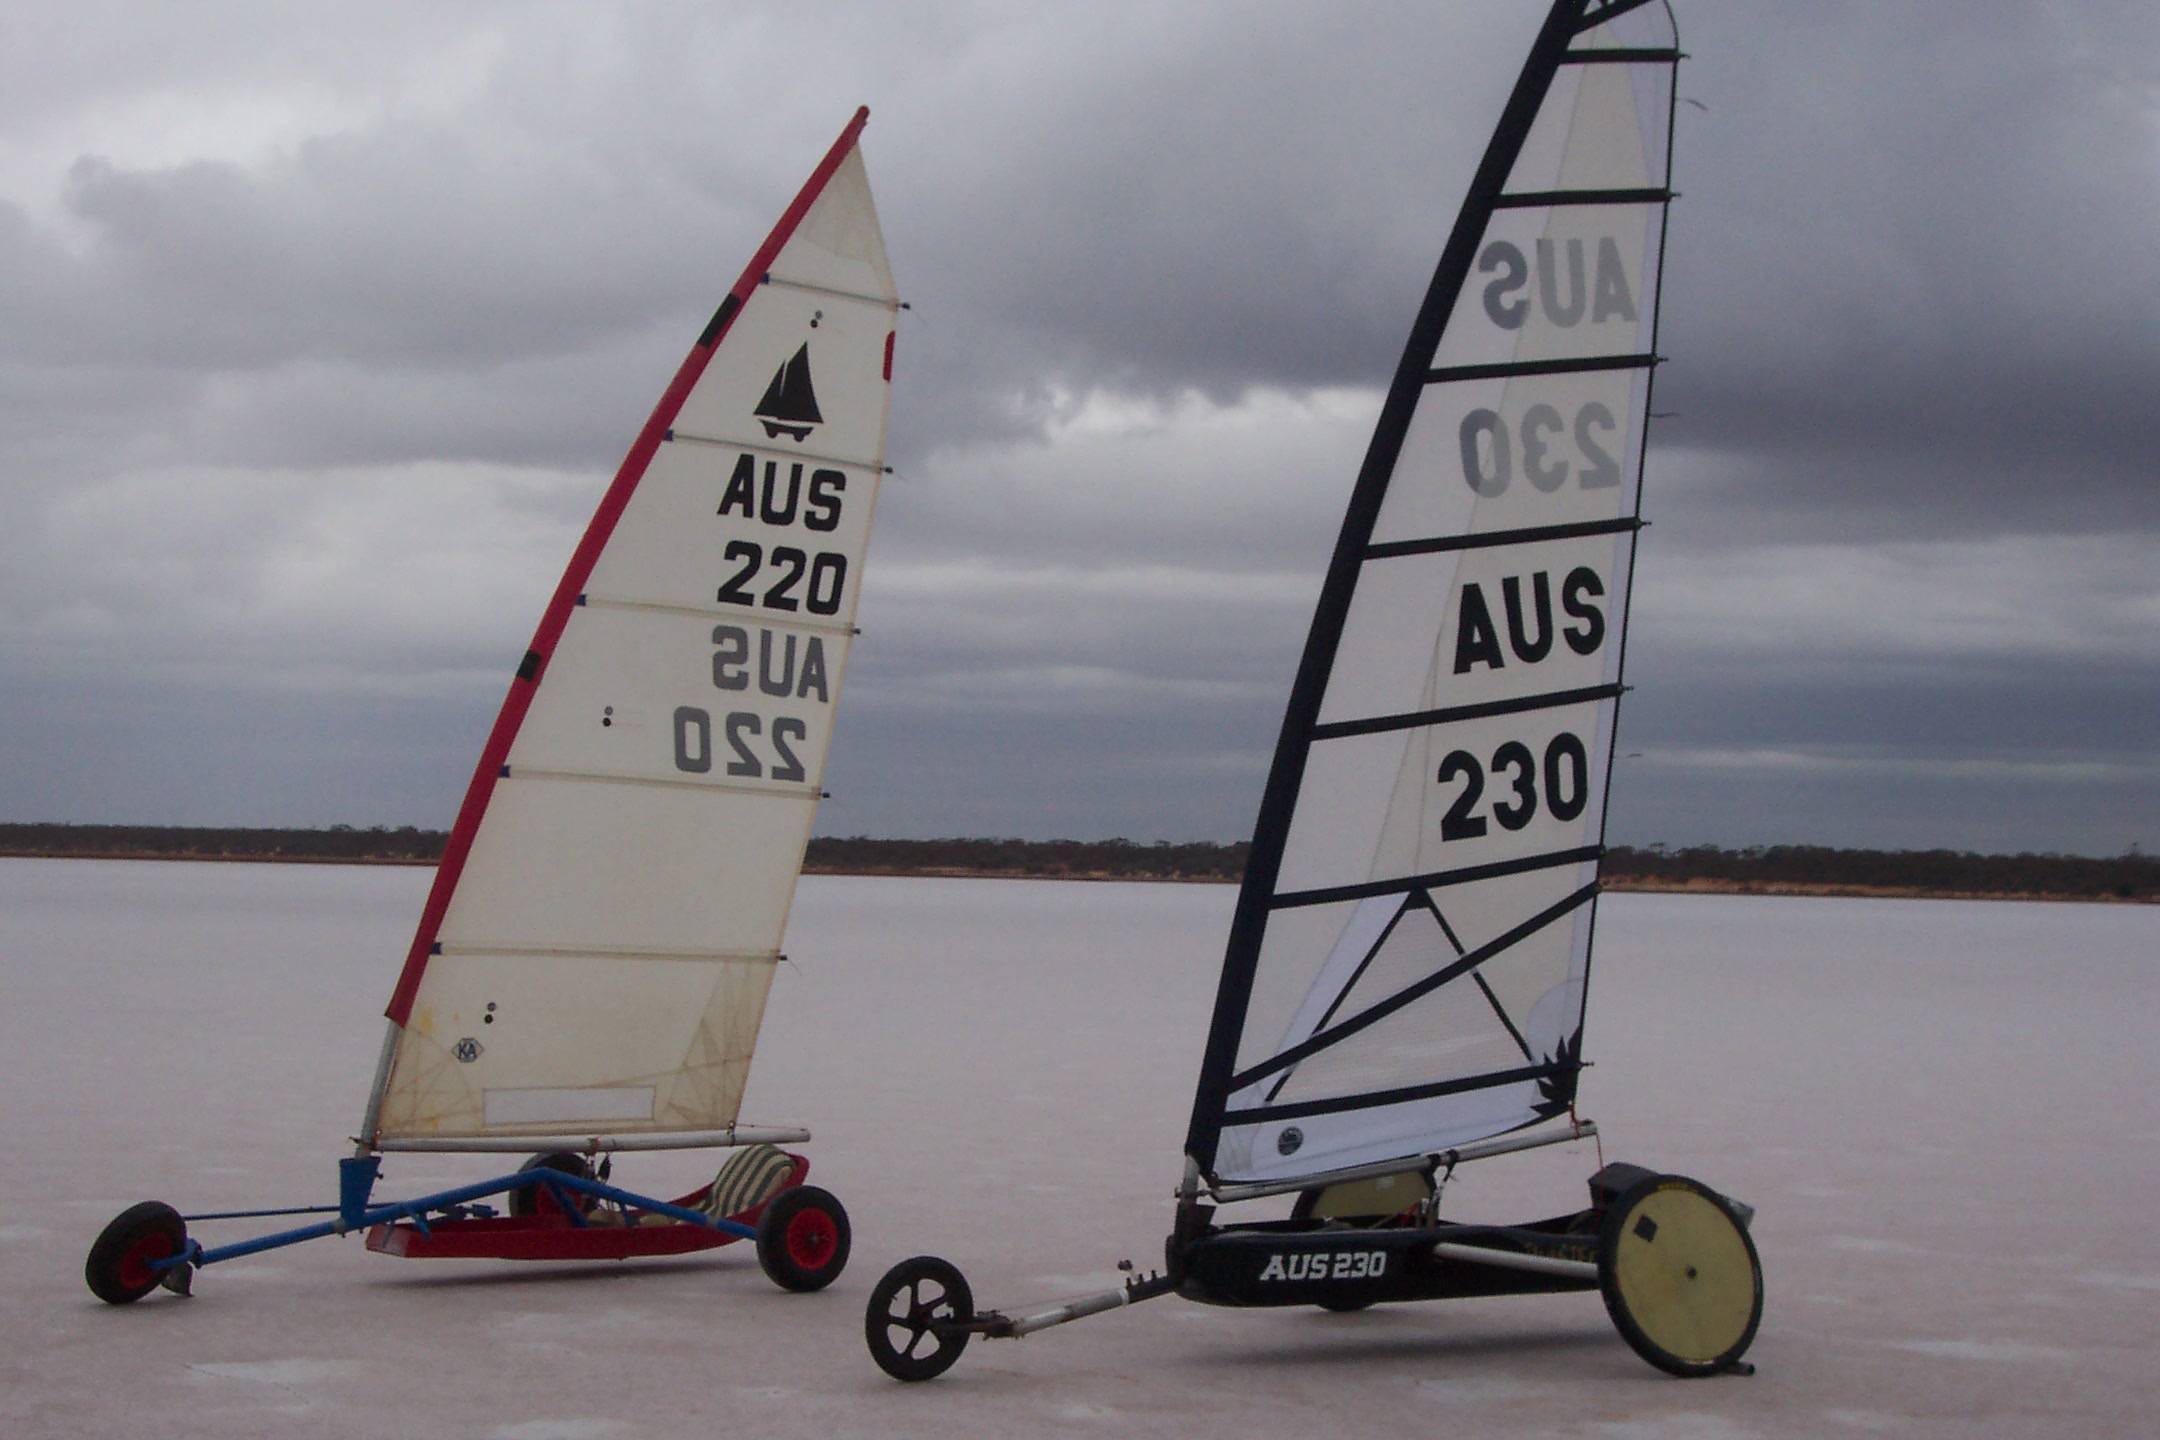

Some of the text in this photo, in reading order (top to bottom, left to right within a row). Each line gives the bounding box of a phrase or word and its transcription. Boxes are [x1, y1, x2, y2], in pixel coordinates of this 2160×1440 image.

[716, 453, 846, 533] AUS
[716, 539, 848, 616] 220
[1453, 566, 1606, 675] AUS
[1437, 732, 1588, 843] 230
[1259, 1251, 1387, 1281] AUS 230
